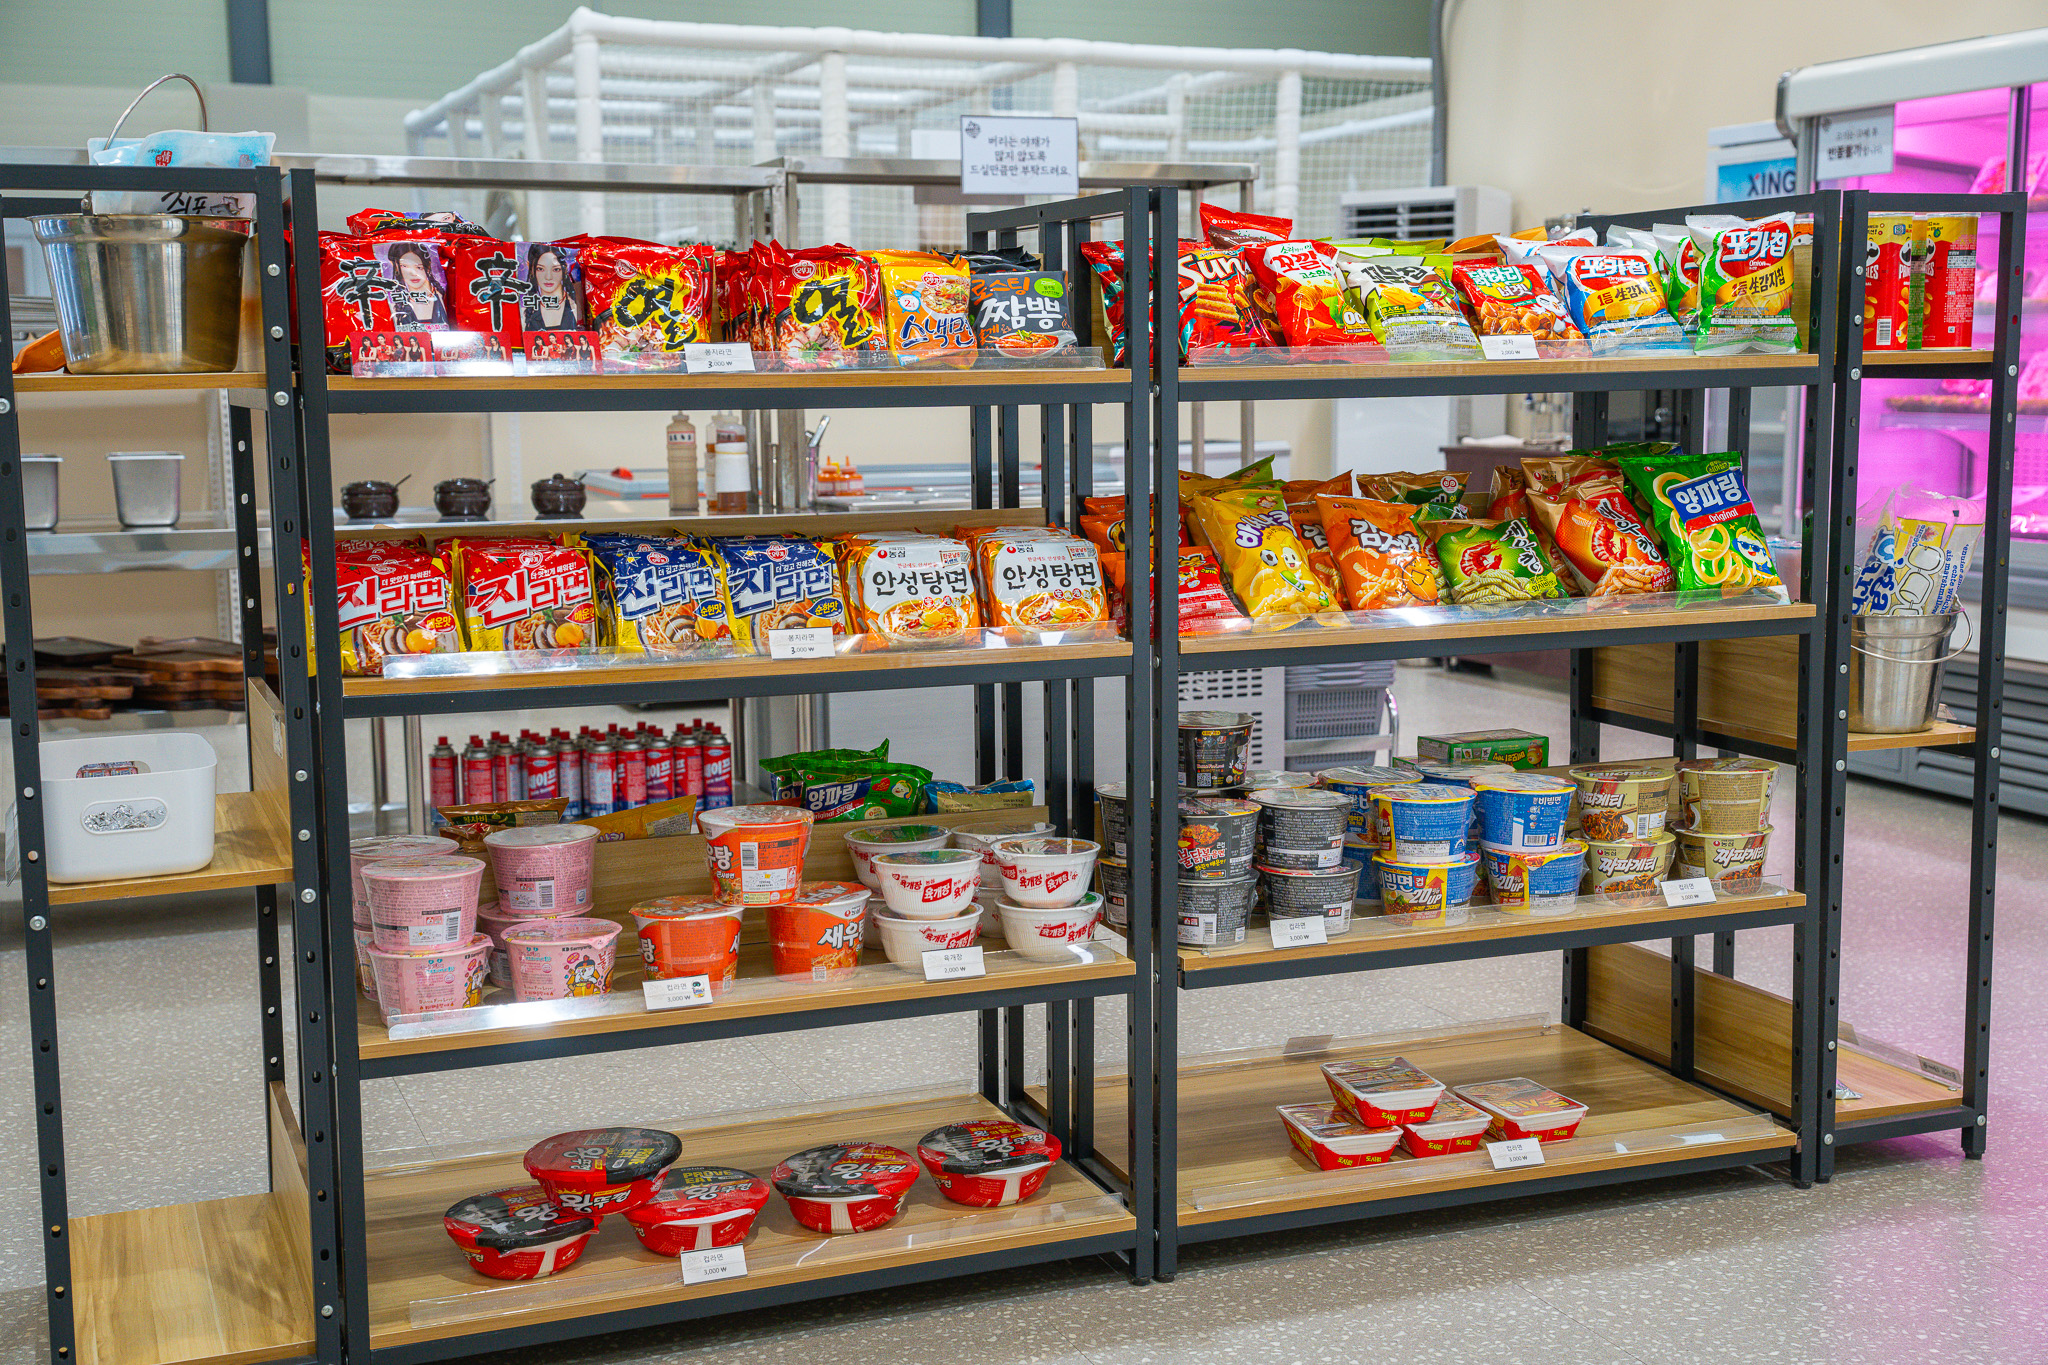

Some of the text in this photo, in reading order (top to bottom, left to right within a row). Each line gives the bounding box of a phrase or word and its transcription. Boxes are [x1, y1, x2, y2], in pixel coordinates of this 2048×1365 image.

[988, 136, 1017, 148] 버리는
[1722, 230, 1788, 263] 포카칩
[1178, 252, 1246, 303] Sun
[1580, 257, 1648, 280] 포카칩
[522, 294, 560, 310] 라면
[971, 277, 1030, 305] 로스팅
[793, 276, 873, 348] 열
[980, 295, 1063, 330] 짬뽕
[901, 314, 975, 349] 스낵면
[1675, 472, 1742, 514] 양파링
[1709, 508, 1739, 523] Original
[888, 550, 906, 558] 농심
[872, 567, 968, 596] 안성탕면
[1002, 562, 1097, 590] 안성탕면
[476, 567, 591, 629] 진라면
[615, 564, 716, 621] 진라면
[727, 562, 833, 619] 진라면
[338, 575, 447, 632] 진라면
[700, 604, 723, 617] 순한맛
[815, 601, 838, 616] 순한맛
[808, 783, 859, 811] 양파링
[1178, 848, 1226, 869] 불닭볶음면
[1598, 857, 1658, 876] 짜파게티
[1713, 846, 1766, 866] 짜파게티
[924, 883, 950, 901] 육개장
[1020, 874, 1042, 888] 육개장
[1511, 882, 1524, 892] UP
[1427, 894, 1442, 905] UP
[1041, 927, 1065, 936] 육개장
[683, 1170, 731, 1178] PROVE
[559, 1190, 632, 1213] 왕뚜껑
[703, 1253, 724, 1262] 컵라면
